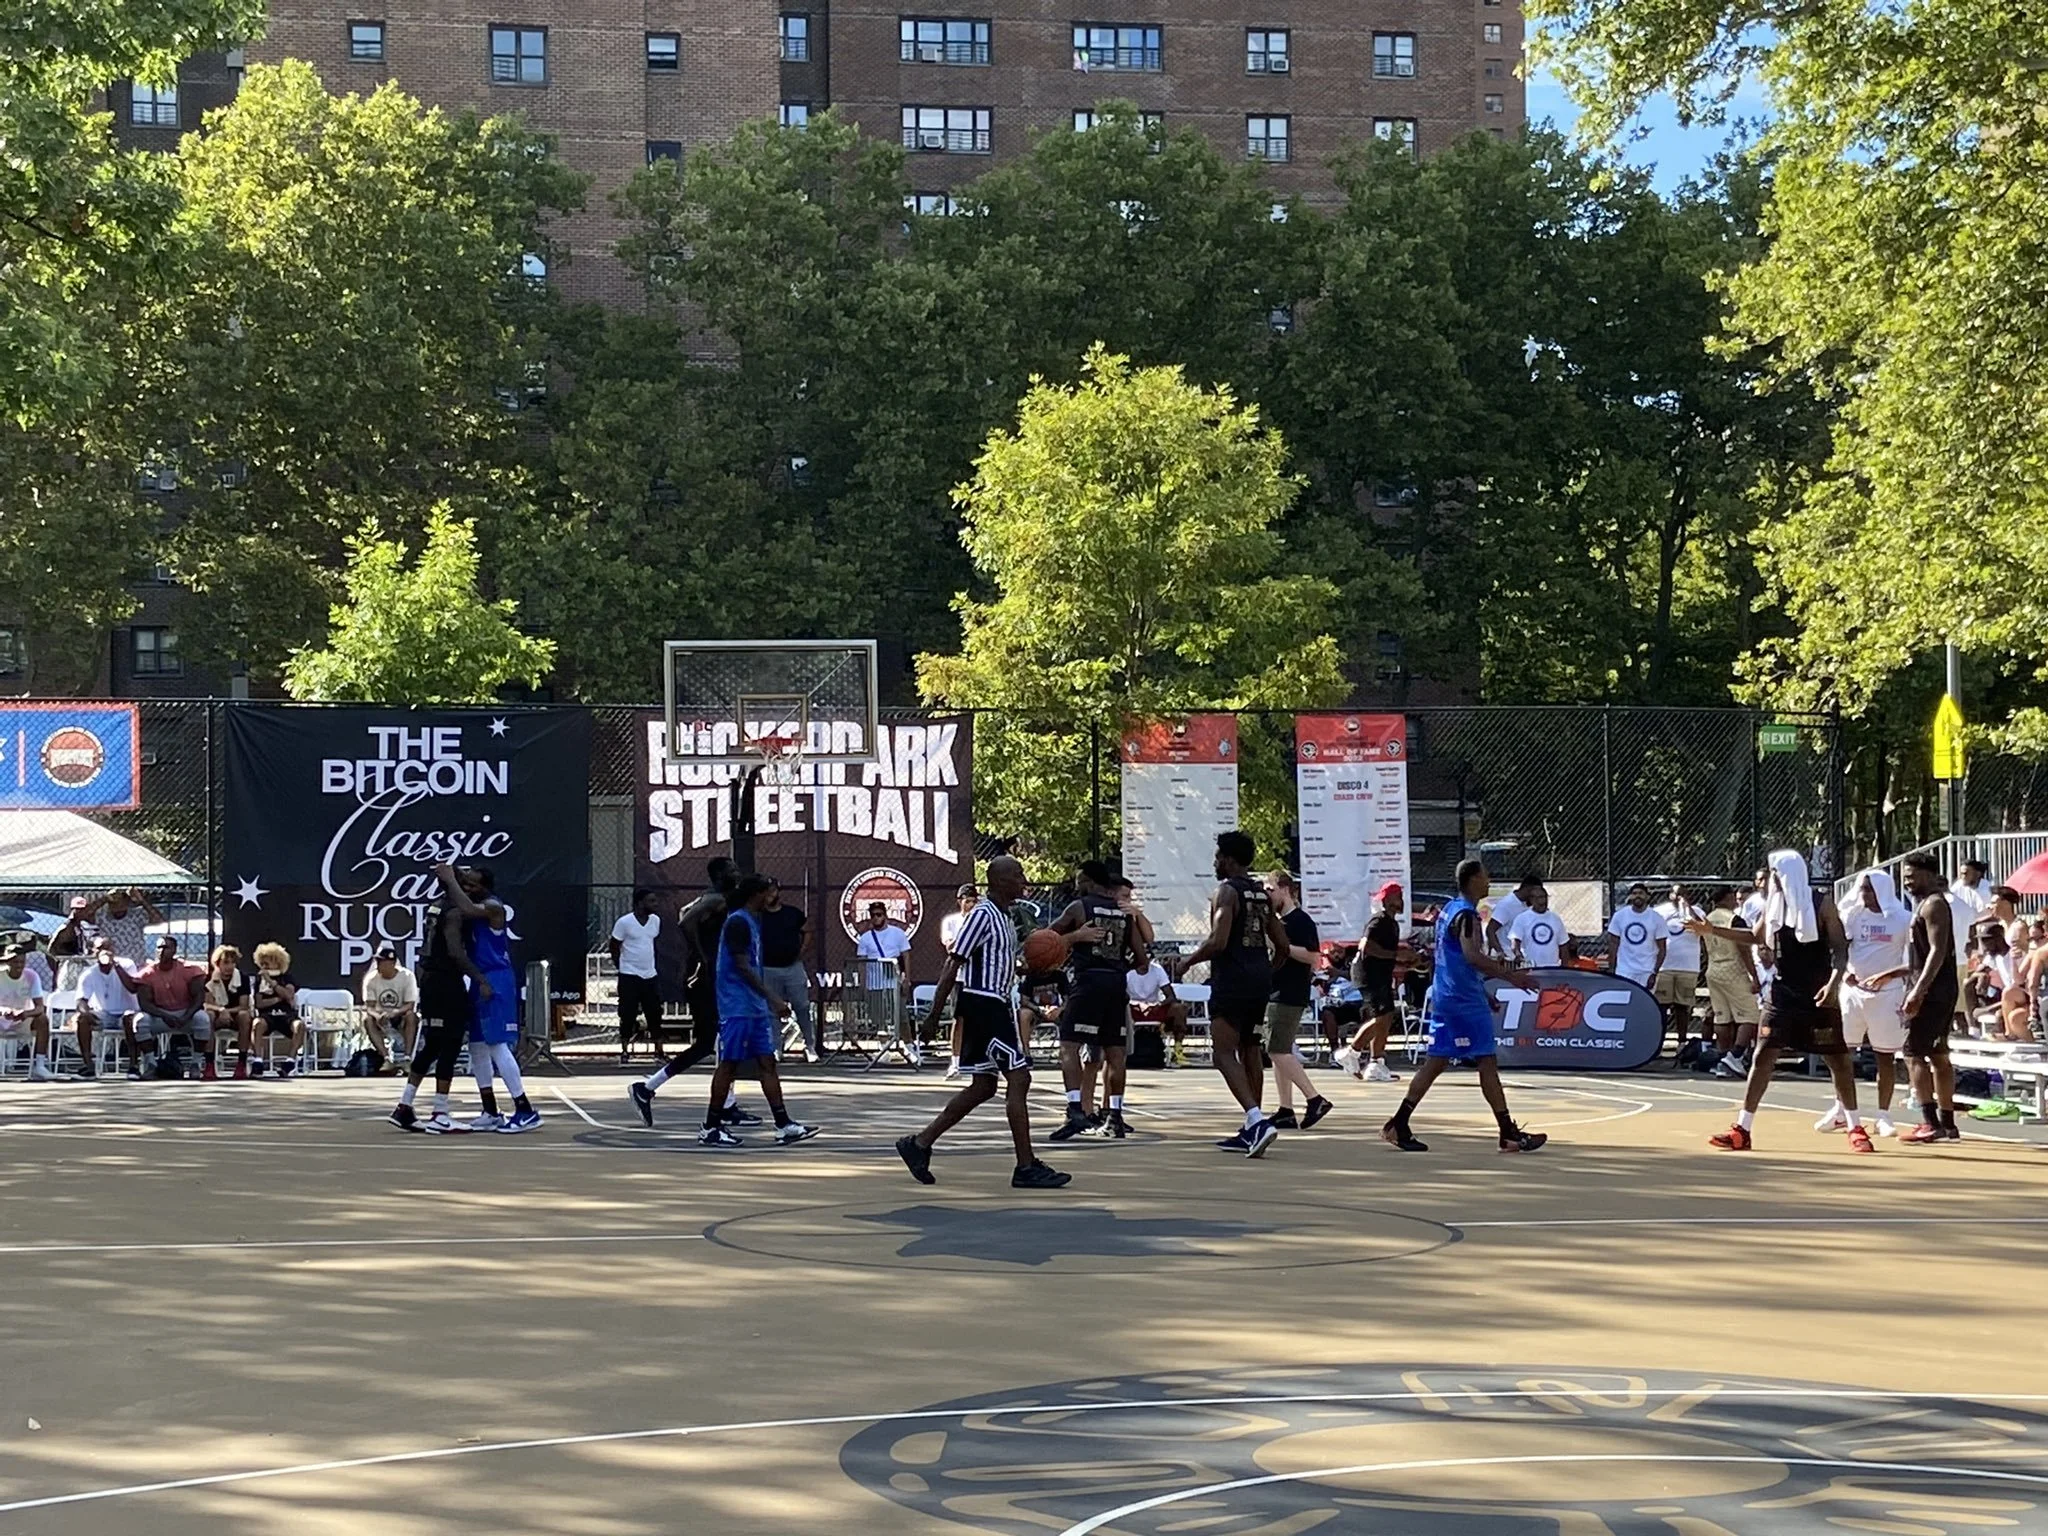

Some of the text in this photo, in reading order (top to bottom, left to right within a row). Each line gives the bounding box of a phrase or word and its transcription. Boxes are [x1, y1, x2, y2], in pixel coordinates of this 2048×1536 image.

[368, 726, 463, 761] THE
[1771, 732, 1796, 745] EXIT
[322, 759, 508, 794] BITCOIN
[1337, 780, 1369, 790] DISCO 4
[321, 772, 514, 899] Classic
[562, 991, 580, 1000] App
[1569, 1038, 1625, 1049] CLASSIC
